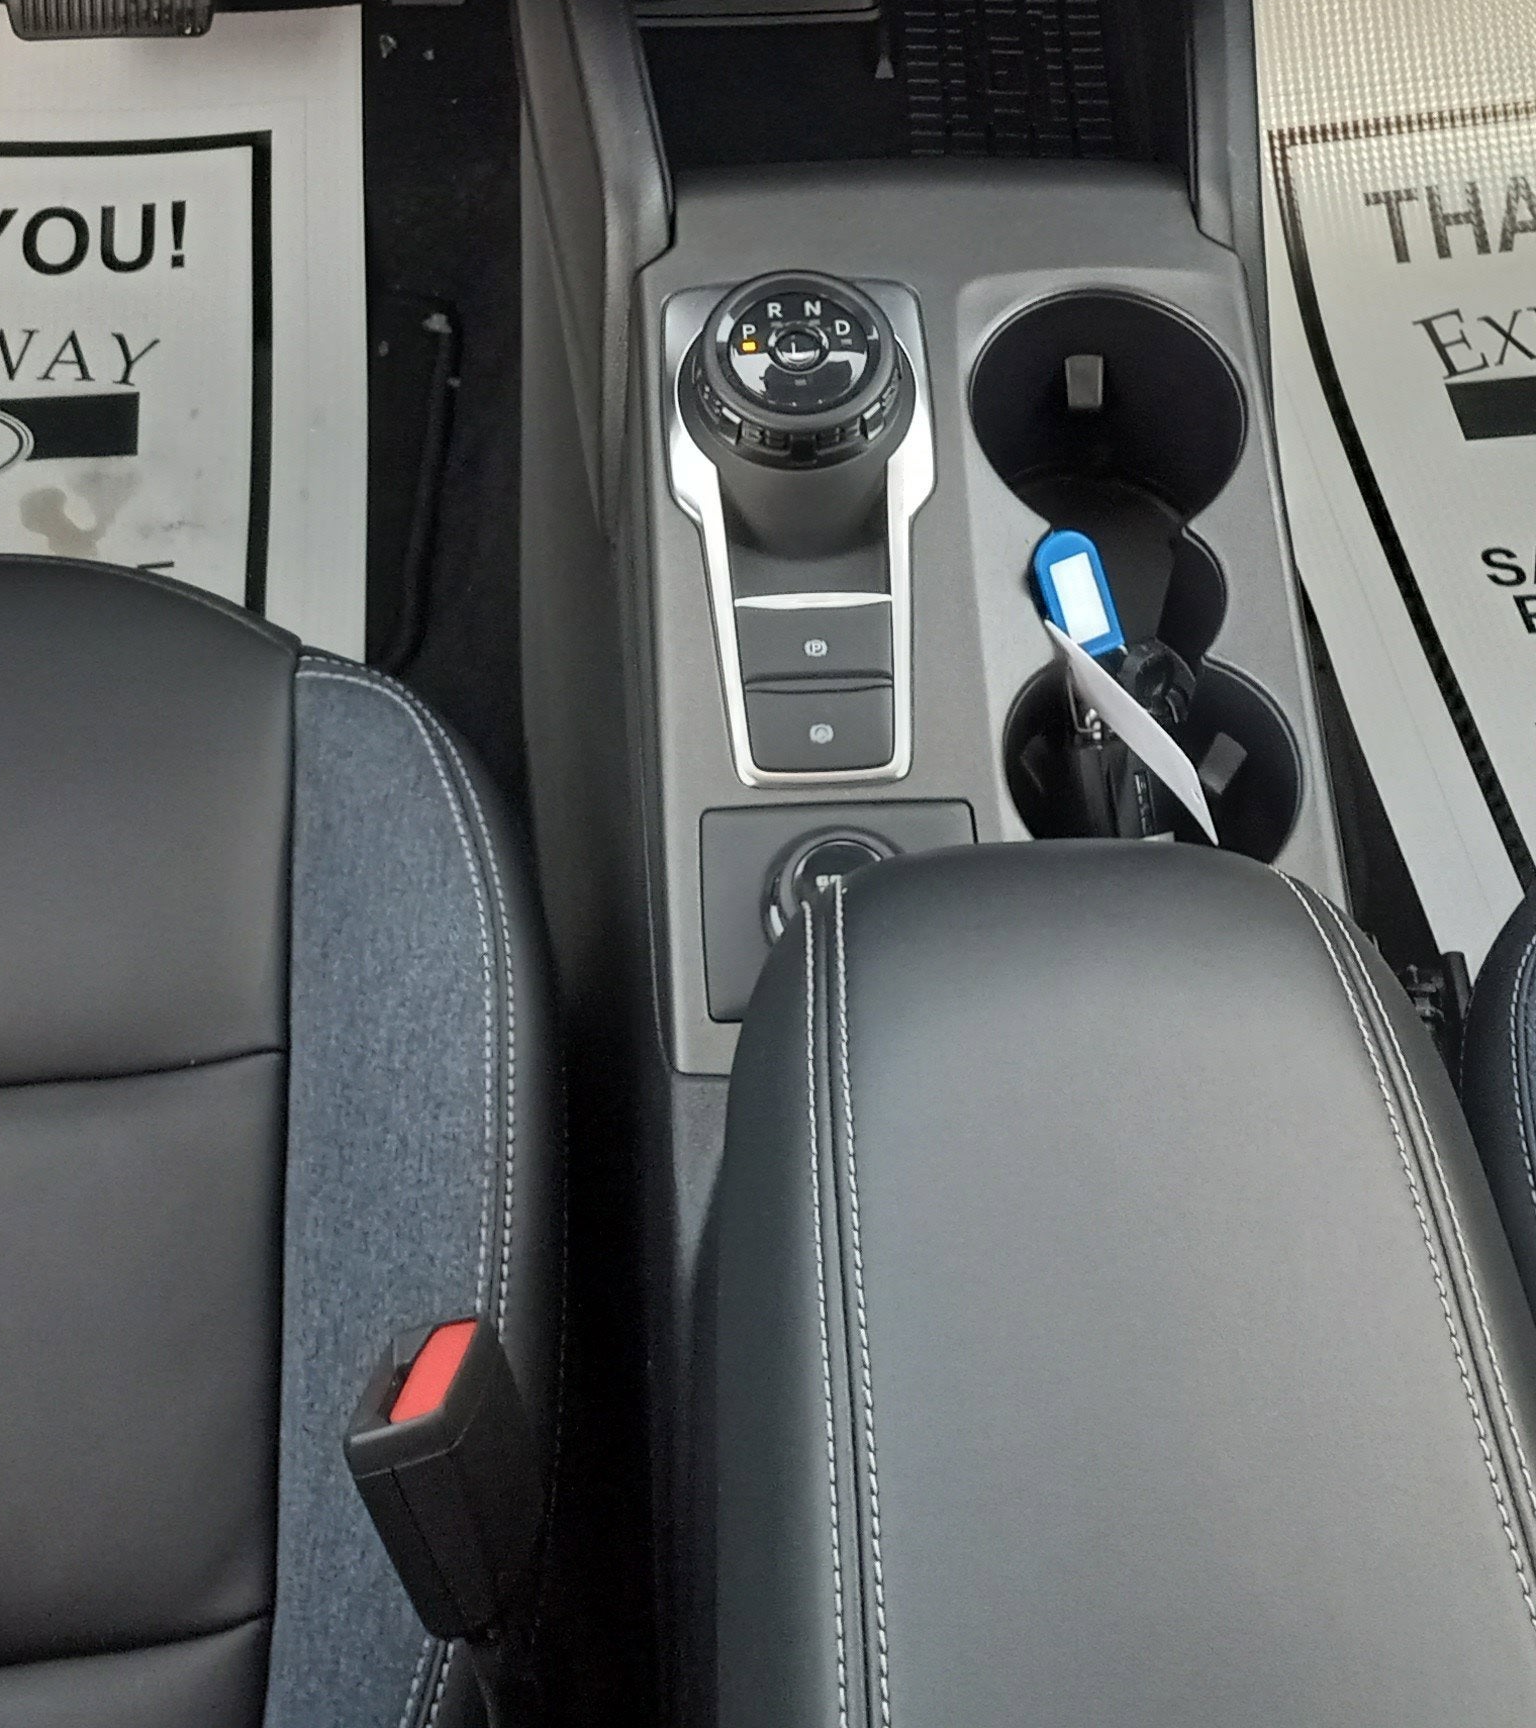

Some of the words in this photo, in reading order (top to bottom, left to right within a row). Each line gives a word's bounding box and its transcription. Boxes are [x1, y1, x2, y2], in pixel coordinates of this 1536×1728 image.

[767, 302, 783, 319] R
[804, 300, 822, 317] N
[742, 324, 756, 340] P
[835, 319, 851, 335] D
